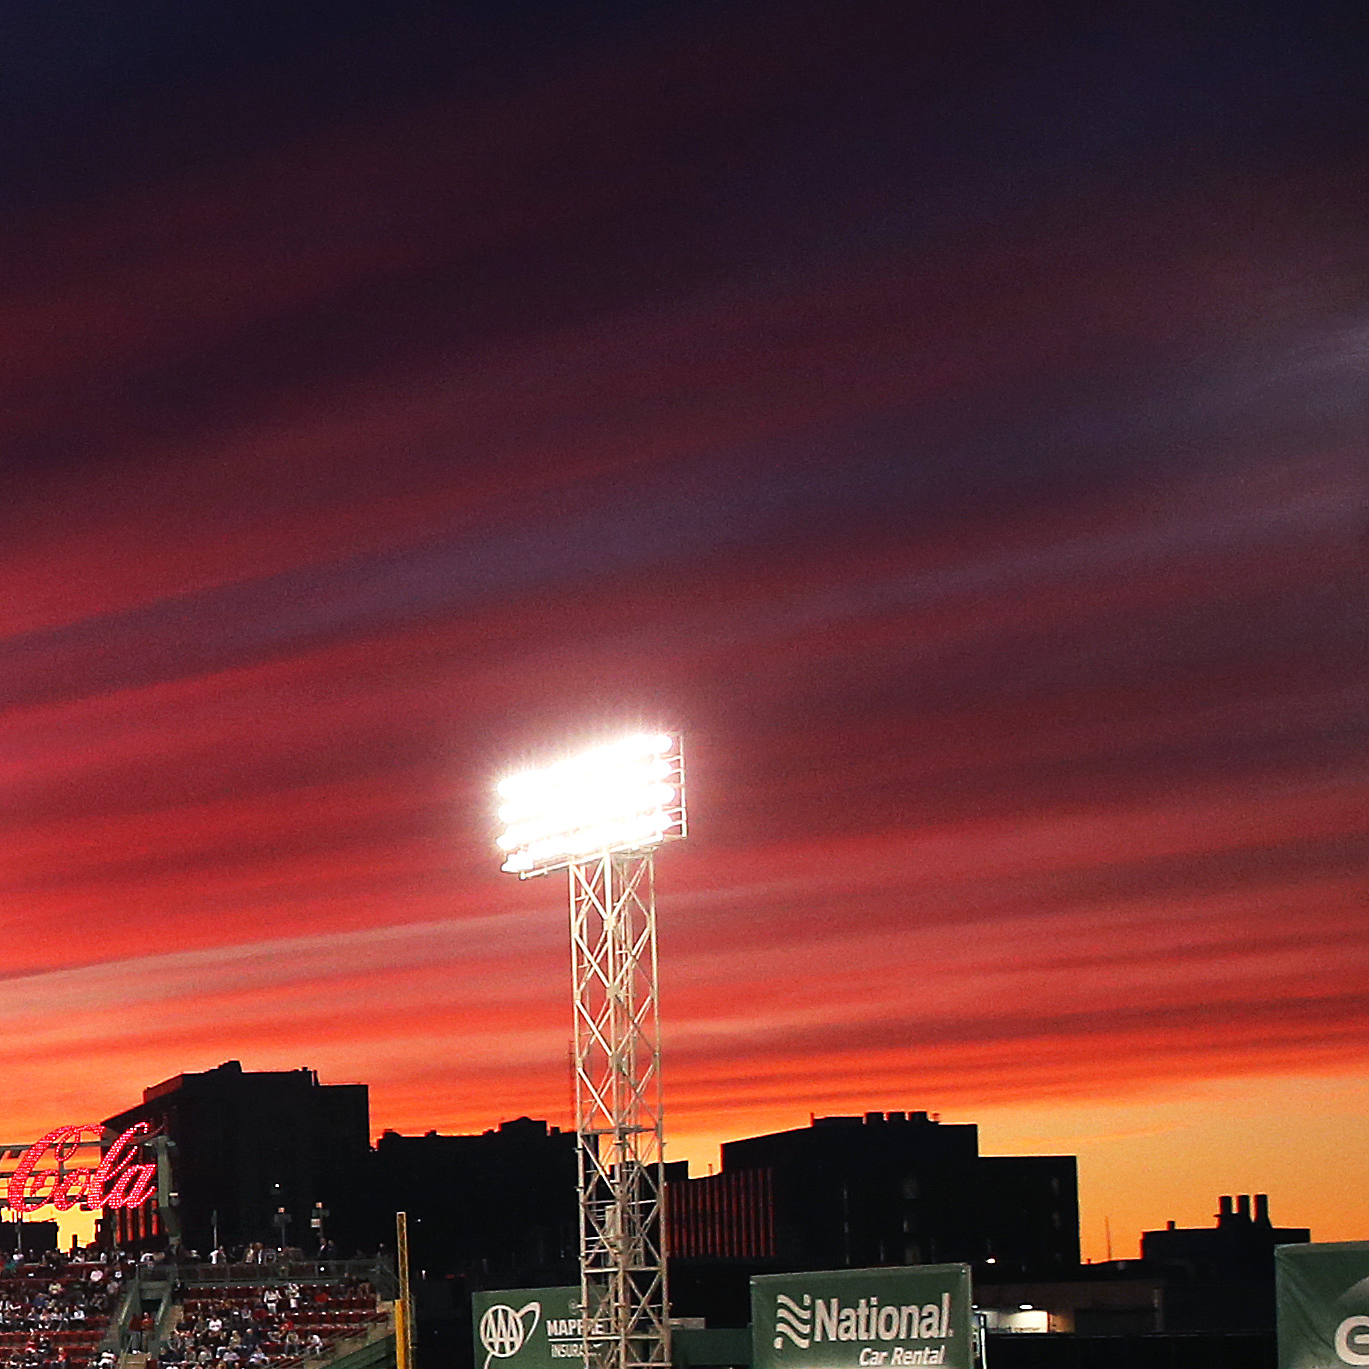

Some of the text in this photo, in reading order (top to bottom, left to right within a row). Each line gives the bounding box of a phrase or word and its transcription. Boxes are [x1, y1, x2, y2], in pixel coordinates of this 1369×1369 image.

[814, 1292, 951, 1342] National
[859, 1345, 946, 1366] Car Rental
